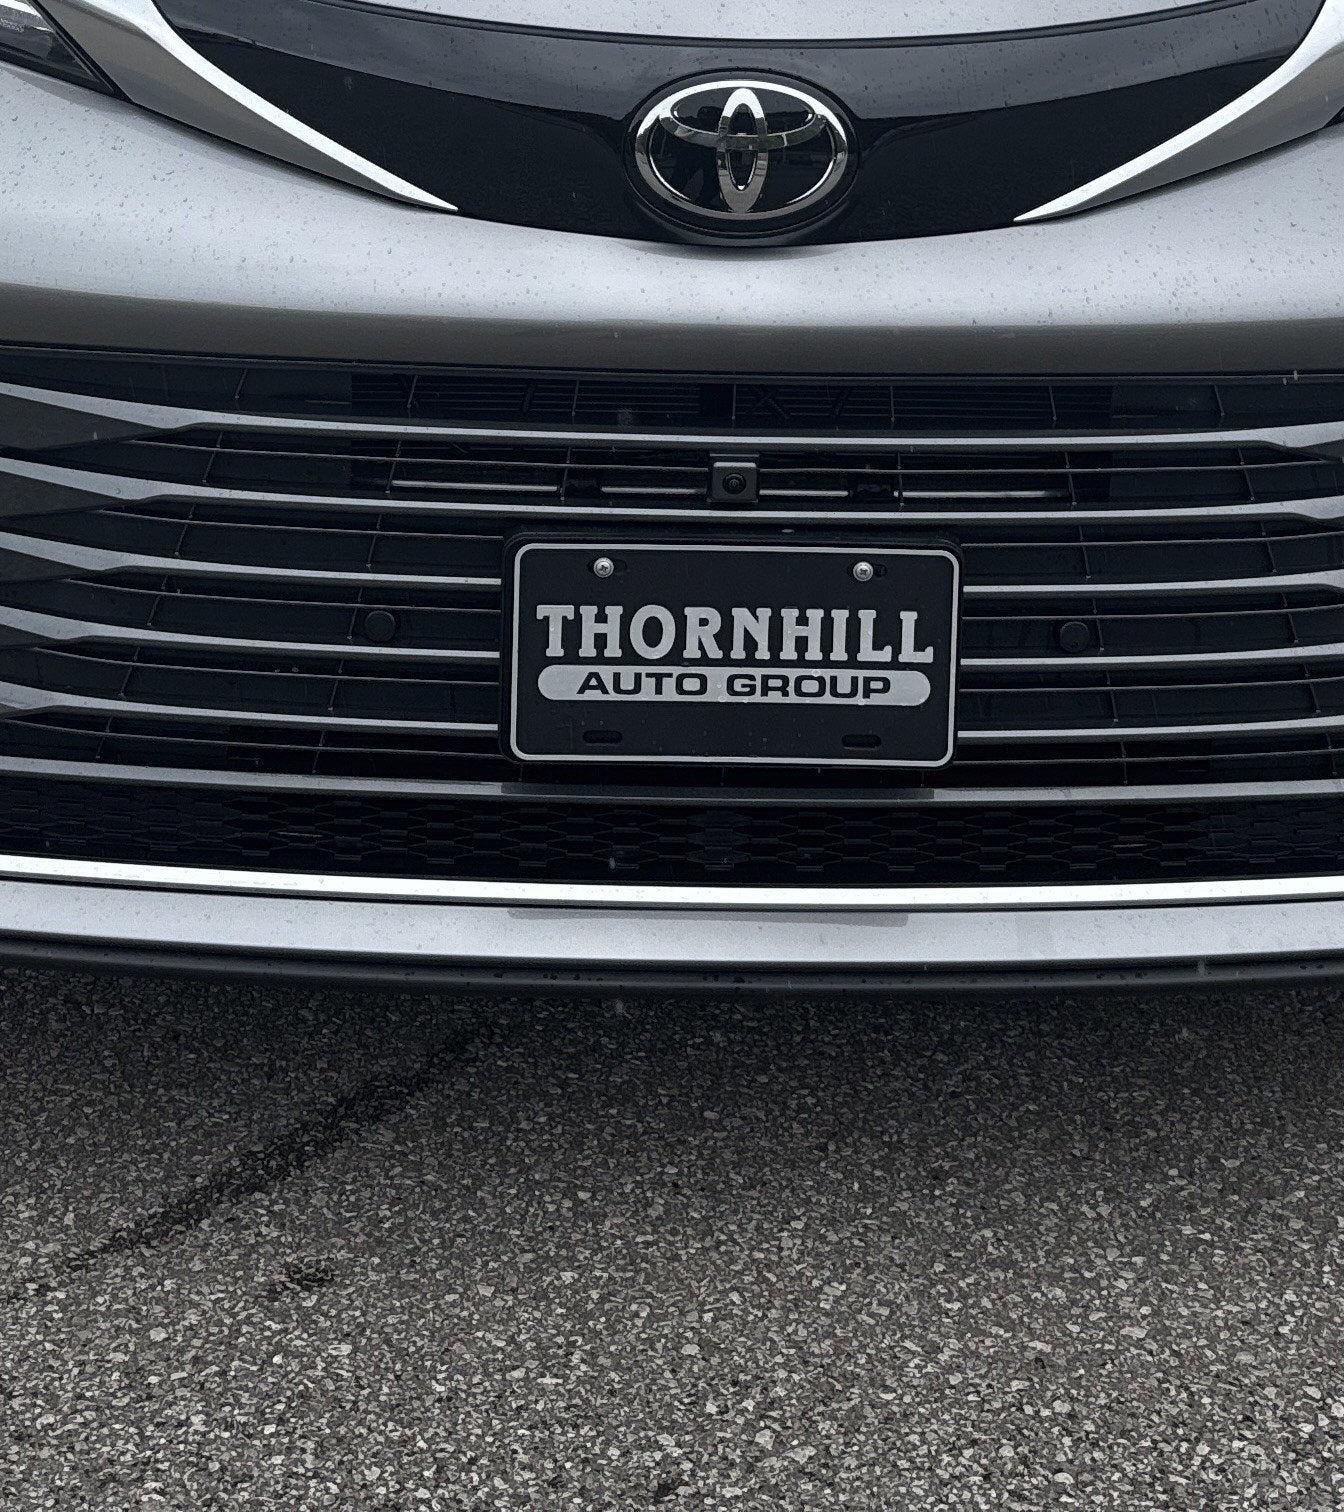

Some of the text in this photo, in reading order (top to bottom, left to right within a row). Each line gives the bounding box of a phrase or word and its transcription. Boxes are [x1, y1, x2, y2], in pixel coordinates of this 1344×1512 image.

[536, 604, 934, 663] THORNHILL
[576, 671, 892, 700] AUTO GROUP
